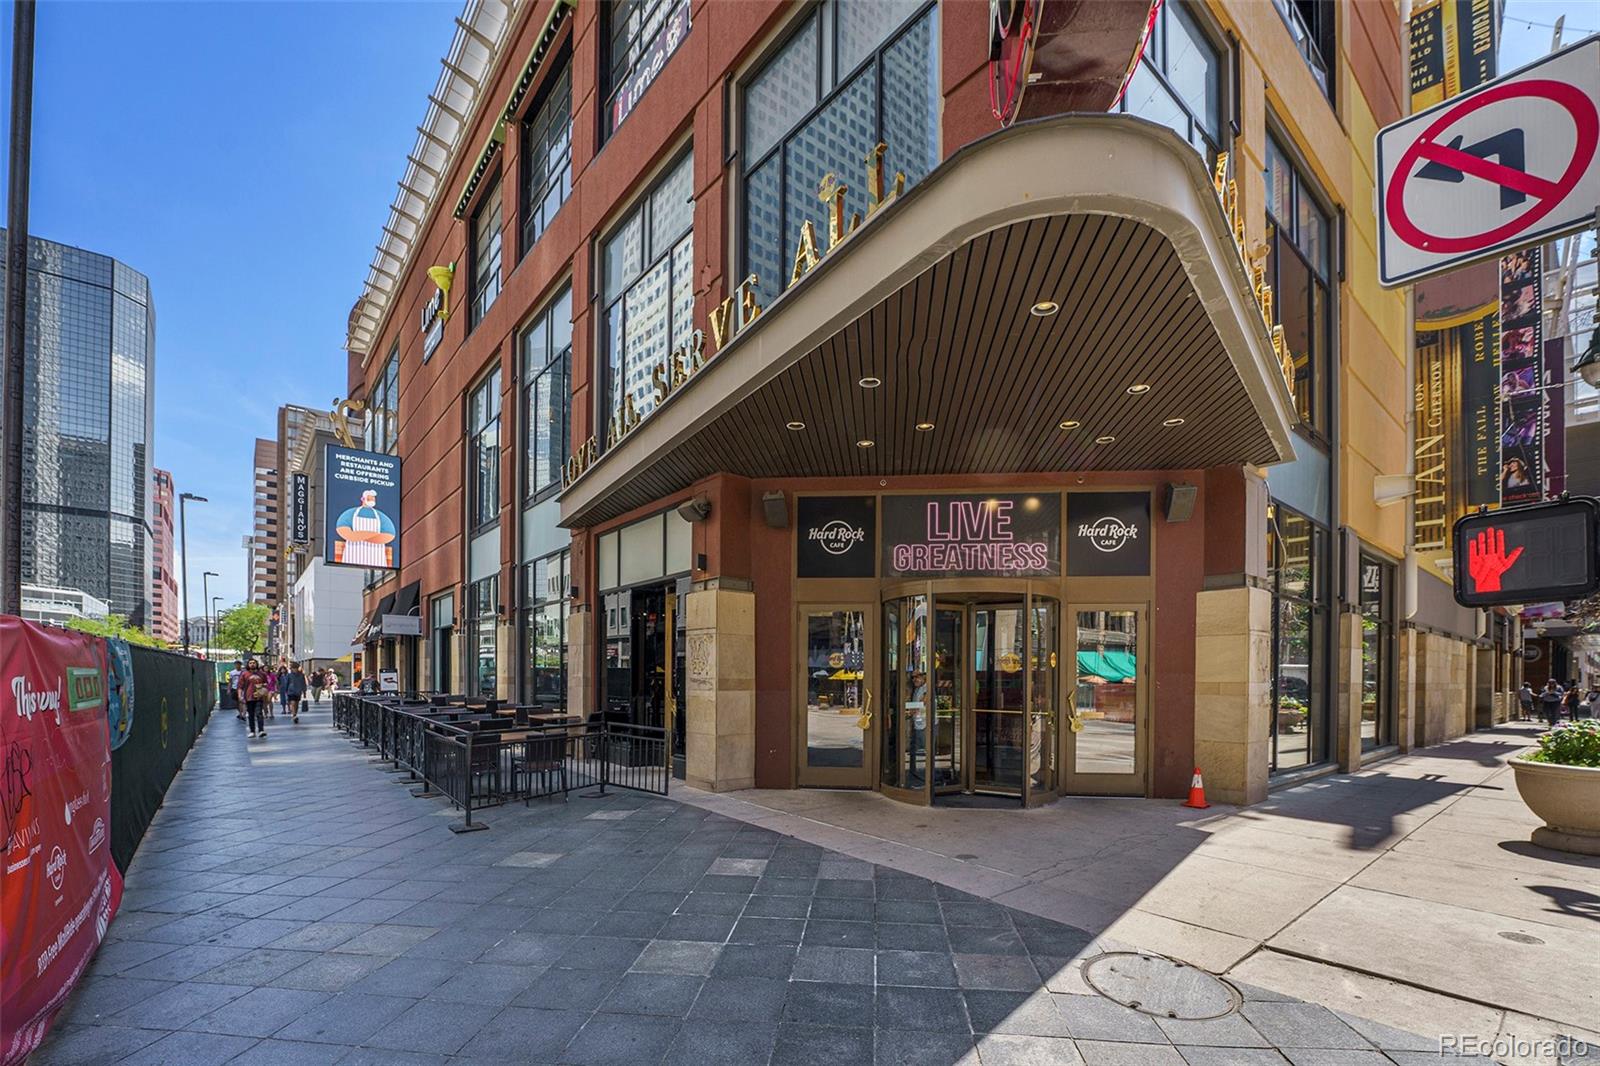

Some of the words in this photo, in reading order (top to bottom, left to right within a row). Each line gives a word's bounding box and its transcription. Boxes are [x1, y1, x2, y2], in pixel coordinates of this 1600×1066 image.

[1472, 12, 1491, 56] COOPER
[560, 434, 598, 491] LOVE
[605, 392, 642, 453] ALL
[651, 272, 762, 408] SERVE
[787, 141, 906, 290] ALL
[1474, 317, 1485, 362] ROBE
[1415, 383, 1424, 411] RON
[1476, 405, 1487, 441] FALL
[335, 453, 378, 467] MERCHANTS
[379, 461, 394, 469] AND
[340, 460, 389, 474] RESTAURANTS
[340, 467, 355, 475] ARE
[355, 470, 390, 480] OFFERING
[1477, 446, 1488, 476] THE
[334, 473, 369, 484] CURBSIDE
[370, 479, 395, 487] PICKUP
[1415, 433, 1446, 550] TITAN
[297, 476, 307, 539] MAGGIANO'S
[927, 500, 1013, 542] LIVE
[808, 527, 838, 540] Hard
[837, 527, 865, 542] Rock
[1078, 524, 1109, 537] Hard
[1108, 524, 1138, 539] Rock
[893, 542, 1048, 572] GREATNESS
[11, 675, 37, 722] This
